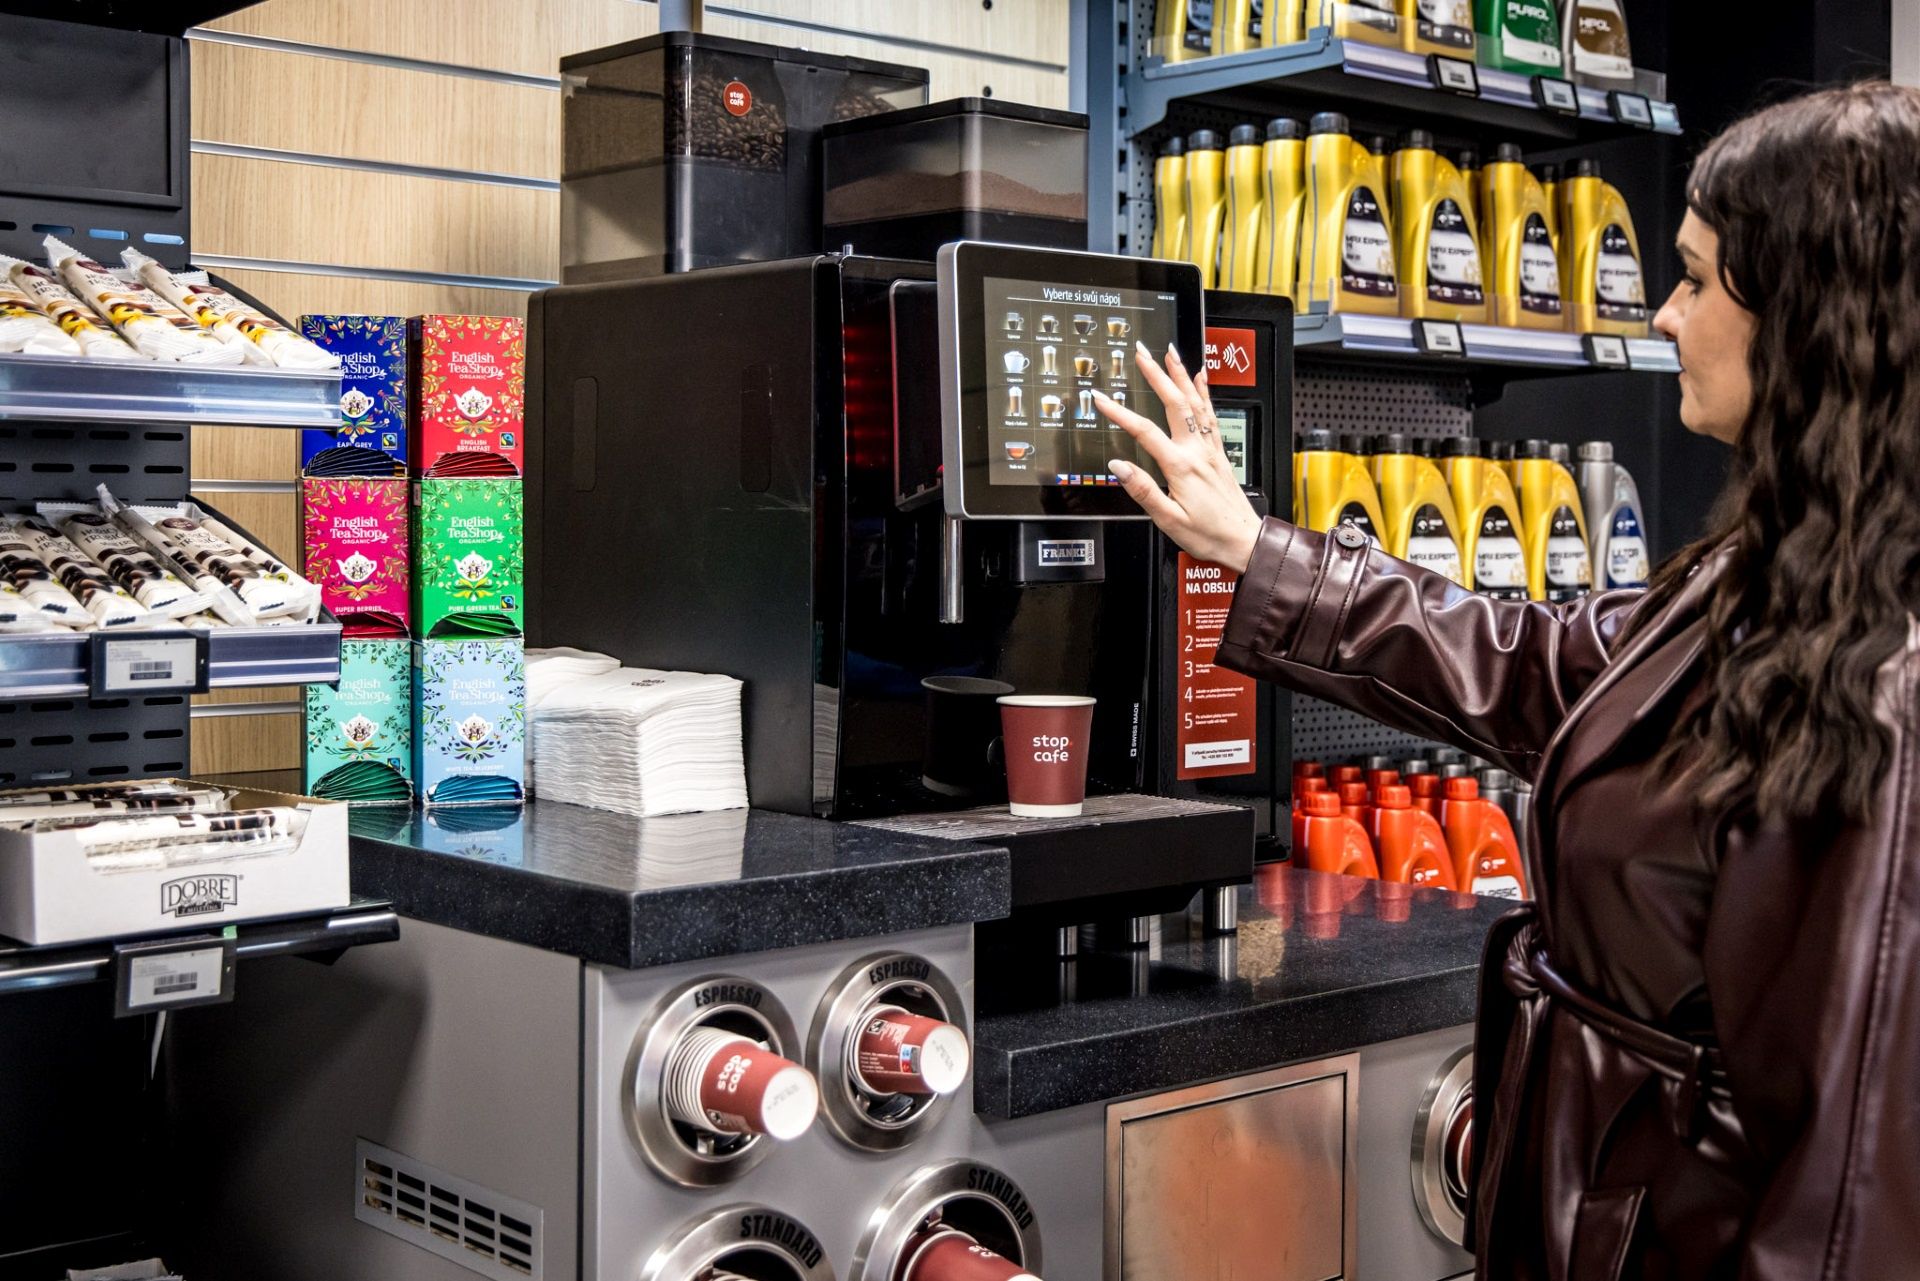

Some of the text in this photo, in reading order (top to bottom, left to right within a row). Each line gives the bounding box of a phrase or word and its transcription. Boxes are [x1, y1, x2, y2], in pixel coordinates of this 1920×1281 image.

[1043, 288, 1121, 307] Vyberte si svůj nápoj
[451, 351, 495, 365] English
[333, 516, 378, 529] English
[451, 515, 494, 529] English
[1042, 548, 1086, 559] FRANKE
[1185, 565, 1221, 580] NÁVOD
[1185, 582, 1201, 594] NA
[356, 605, 382, 613] BERRIES
[1185, 608, 1191, 626] 1
[1184, 635, 1193, 652] 2
[1184, 660, 1193, 678] 3
[452, 678, 496, 691] English
[1184, 686, 1193, 703] 4
[1184, 712, 1193, 730] 5
[1034, 749, 1069, 764] cafe
[869, 960, 930, 985] ESPRESSO
[694, 984, 762, 1008] ESPRESSO
[717, 1054, 742, 1091] stop
[727, 1058, 752, 1093] cafe
[966, 1167, 1033, 1231] STANDARD
[740, 1215, 822, 1269] STANDARD
